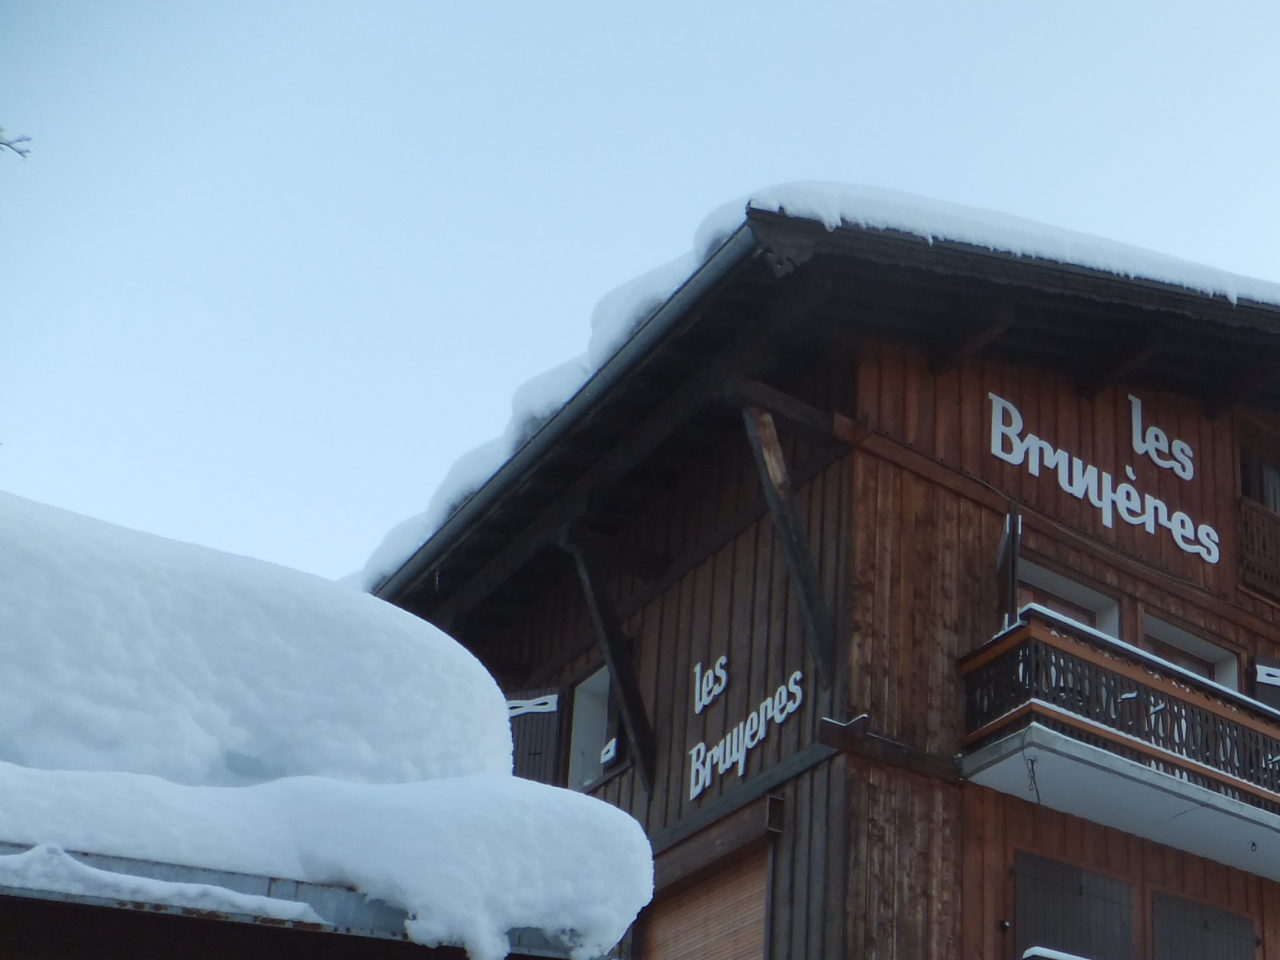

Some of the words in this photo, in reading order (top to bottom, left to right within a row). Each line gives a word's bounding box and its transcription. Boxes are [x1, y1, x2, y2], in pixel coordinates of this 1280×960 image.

[988, 392, 1219, 564] Bruyères
[1128, 394, 1194, 481] les
[694, 656, 727, 715] les
